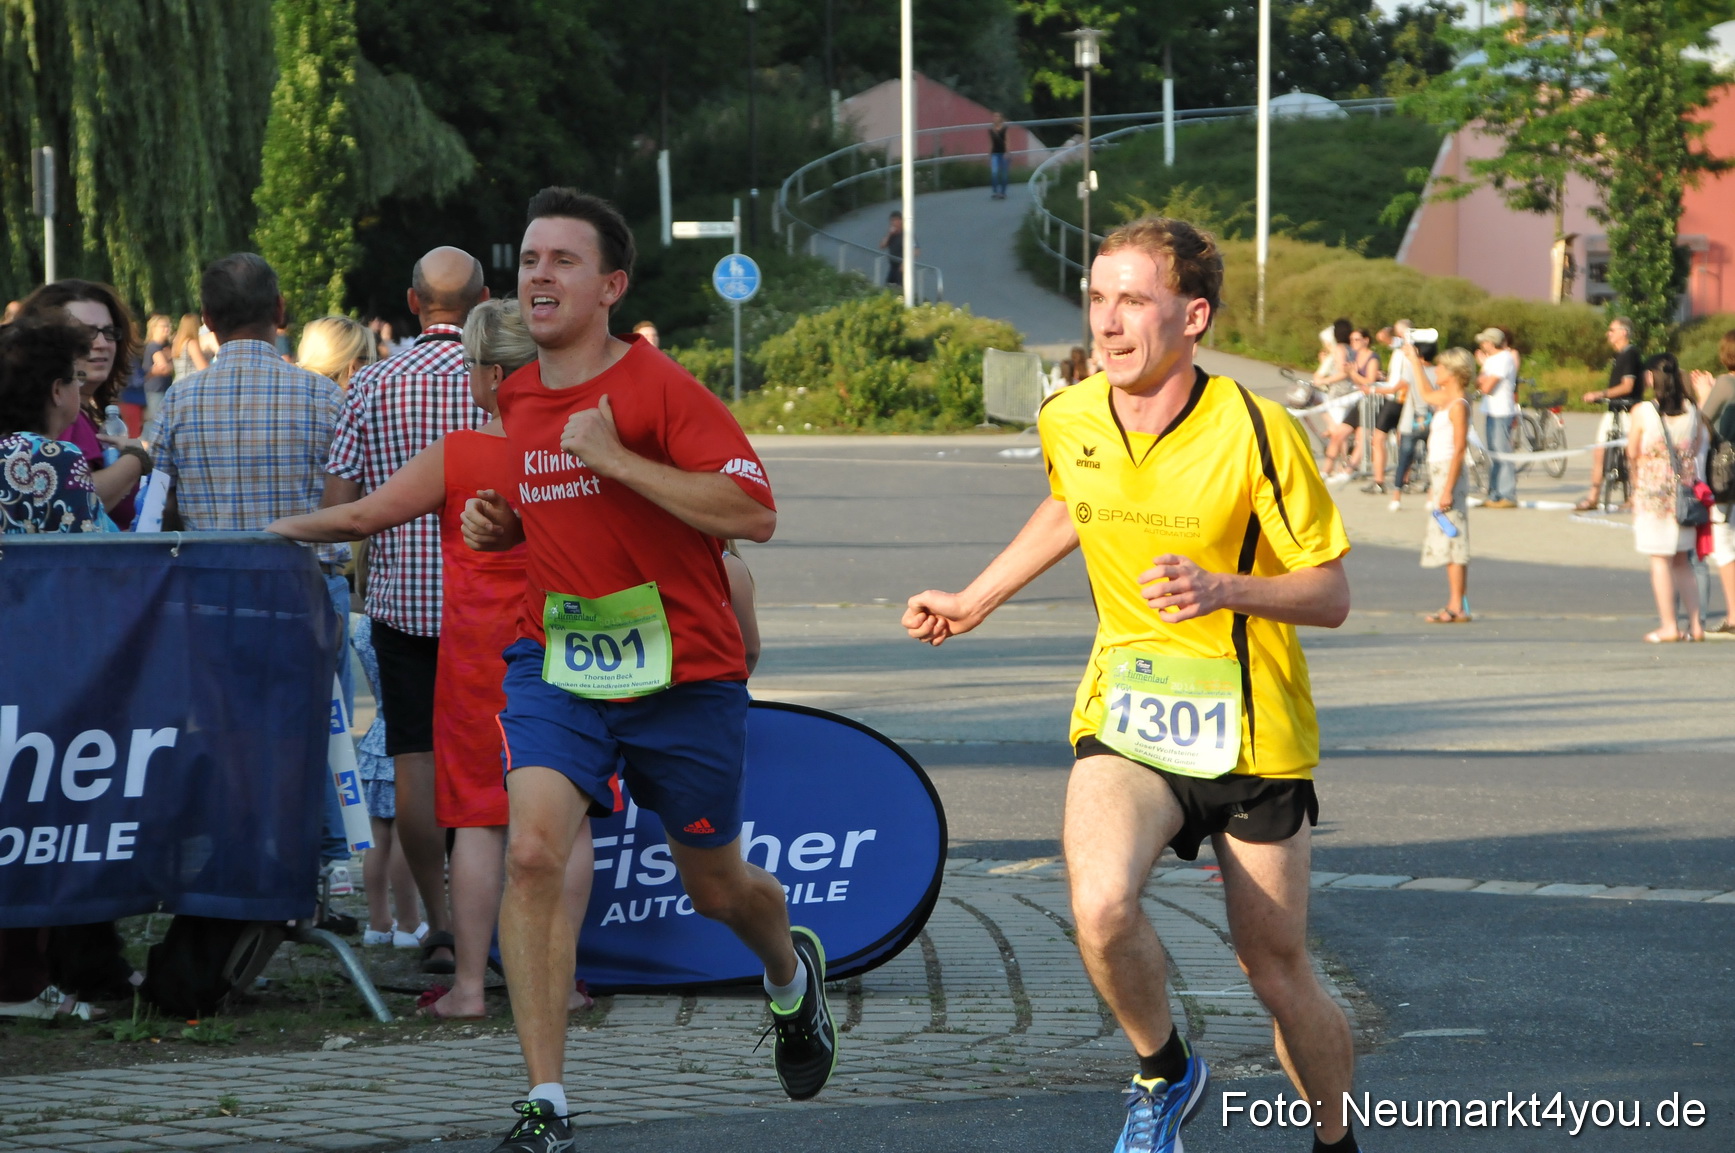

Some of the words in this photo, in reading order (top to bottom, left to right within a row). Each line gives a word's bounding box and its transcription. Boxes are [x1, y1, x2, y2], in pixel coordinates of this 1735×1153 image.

[1075, 458, 1101, 470] erima
[518, 475, 601, 505] Neumarkt
[1097, 508, 1200, 529] SPANGLER
[1143, 527, 1201, 539] AUTOMATION
[564, 627, 645, 672] 601
[616, 672, 633, 680] Beck
[1126, 670, 1170, 685] firmenlauf
[592, 682, 630, 690] Landkreises
[631, 680, 660, 688] Neumarkt
[1110, 692, 1226, 750] 1301
[1133, 748, 1173, 763] SPANGLER
[1174, 757, 1196, 766] GmbH
[1134, 741, 1156, 752] Josef
[1156, 746, 1199, 758] Wolfsteiner
[592, 820, 877, 890] Fisher
